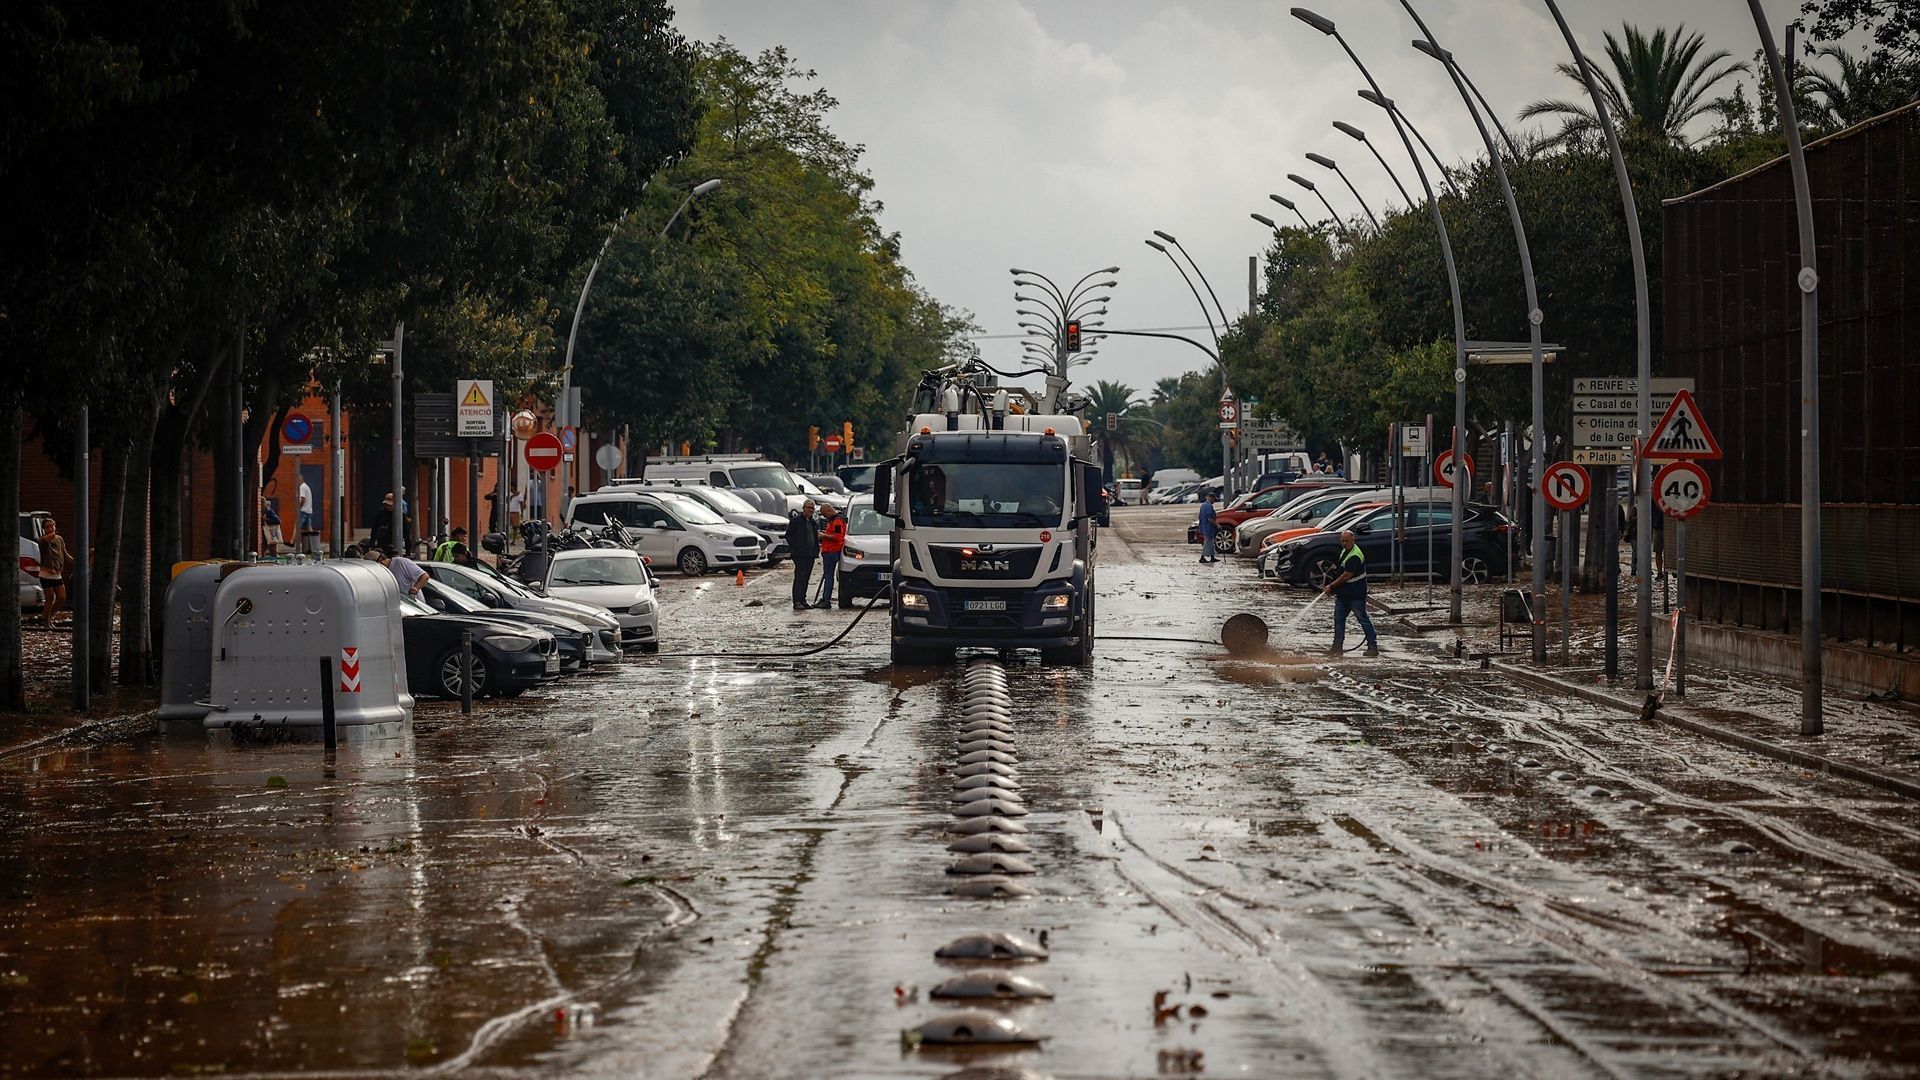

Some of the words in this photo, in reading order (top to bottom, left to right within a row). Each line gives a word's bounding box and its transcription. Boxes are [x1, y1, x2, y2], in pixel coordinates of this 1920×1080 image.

[1590, 381, 1623, 390] RENFE
[1590, 399, 1617, 408] Casal
[1620, 400, 1632, 408] de
[1590, 419, 1624, 428] Oficina
[1590, 432, 1601, 442] de
[1605, 432, 1613, 442] la
[1589, 452, 1616, 463] Platja
[1665, 481, 1699, 499] 40
[961, 560, 1009, 570] MAN
